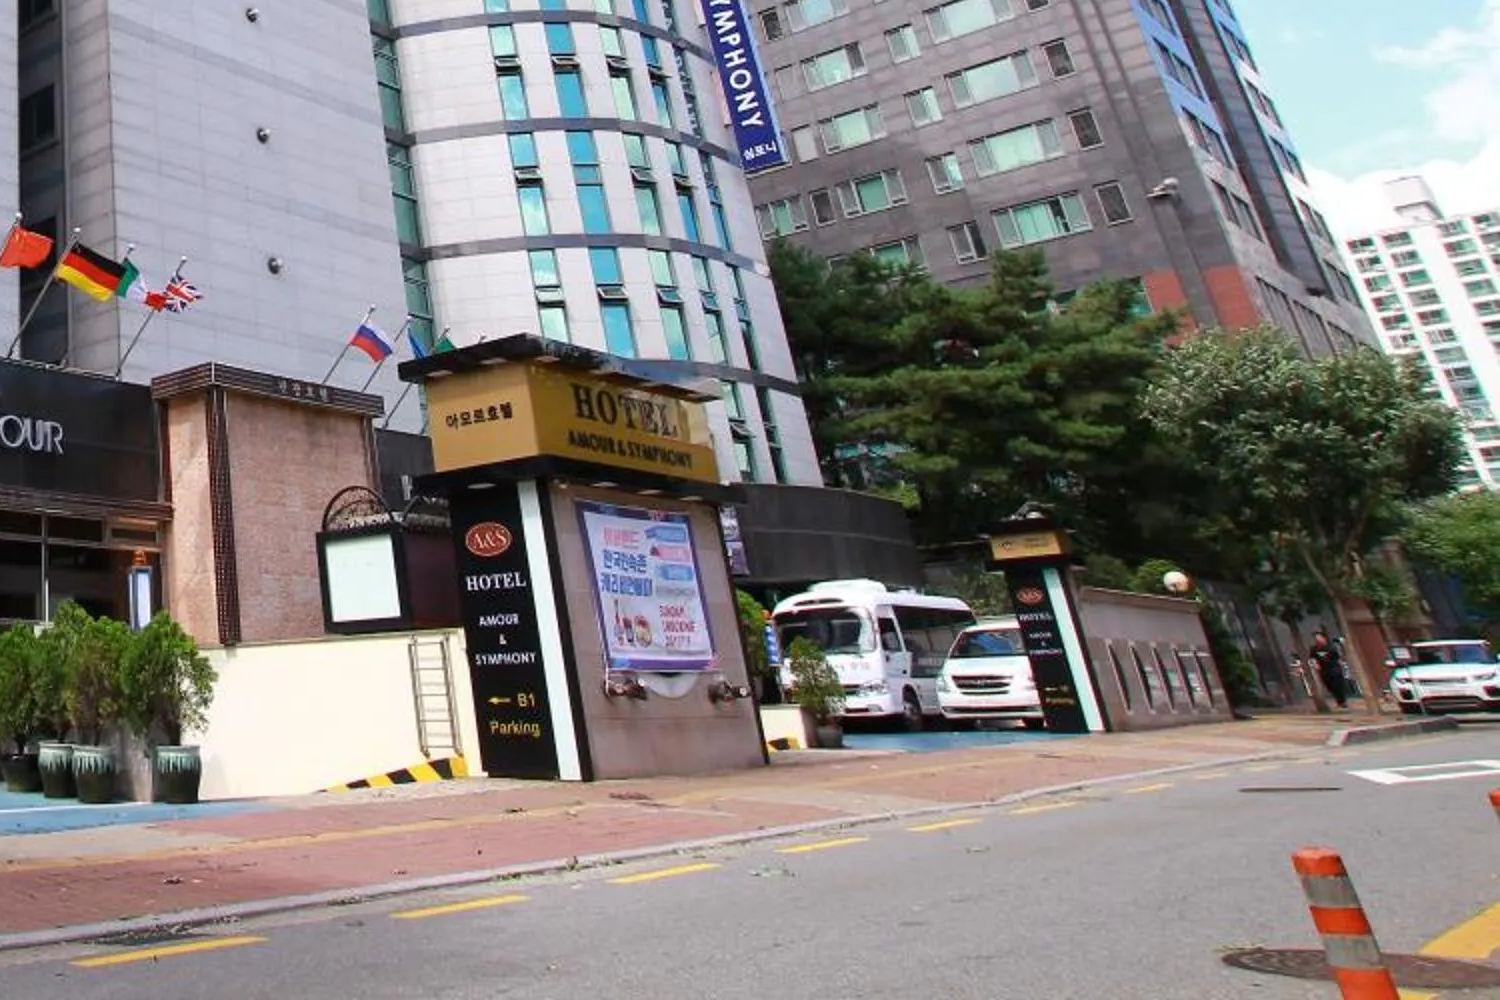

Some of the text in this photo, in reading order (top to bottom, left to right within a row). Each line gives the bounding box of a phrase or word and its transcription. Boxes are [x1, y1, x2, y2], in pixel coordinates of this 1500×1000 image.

[743, 140, 777, 161] 심포니
[445, 401, 514, 430] 아모르호텔
[569, 382, 679, 438] HOTEL
[567, 430, 615, 455] AMOUR
[627, 440, 693, 470] SYMPHONY
[473, 527, 508, 551] A&S
[466, 570, 527, 592] HOTEL
[478, 613, 519, 626] AMOUR
[499, 633, 507, 645] &
[475, 652, 536, 666] SYMPHONY
[517, 692, 536, 708] B1
[489, 720, 541, 738] Parking
